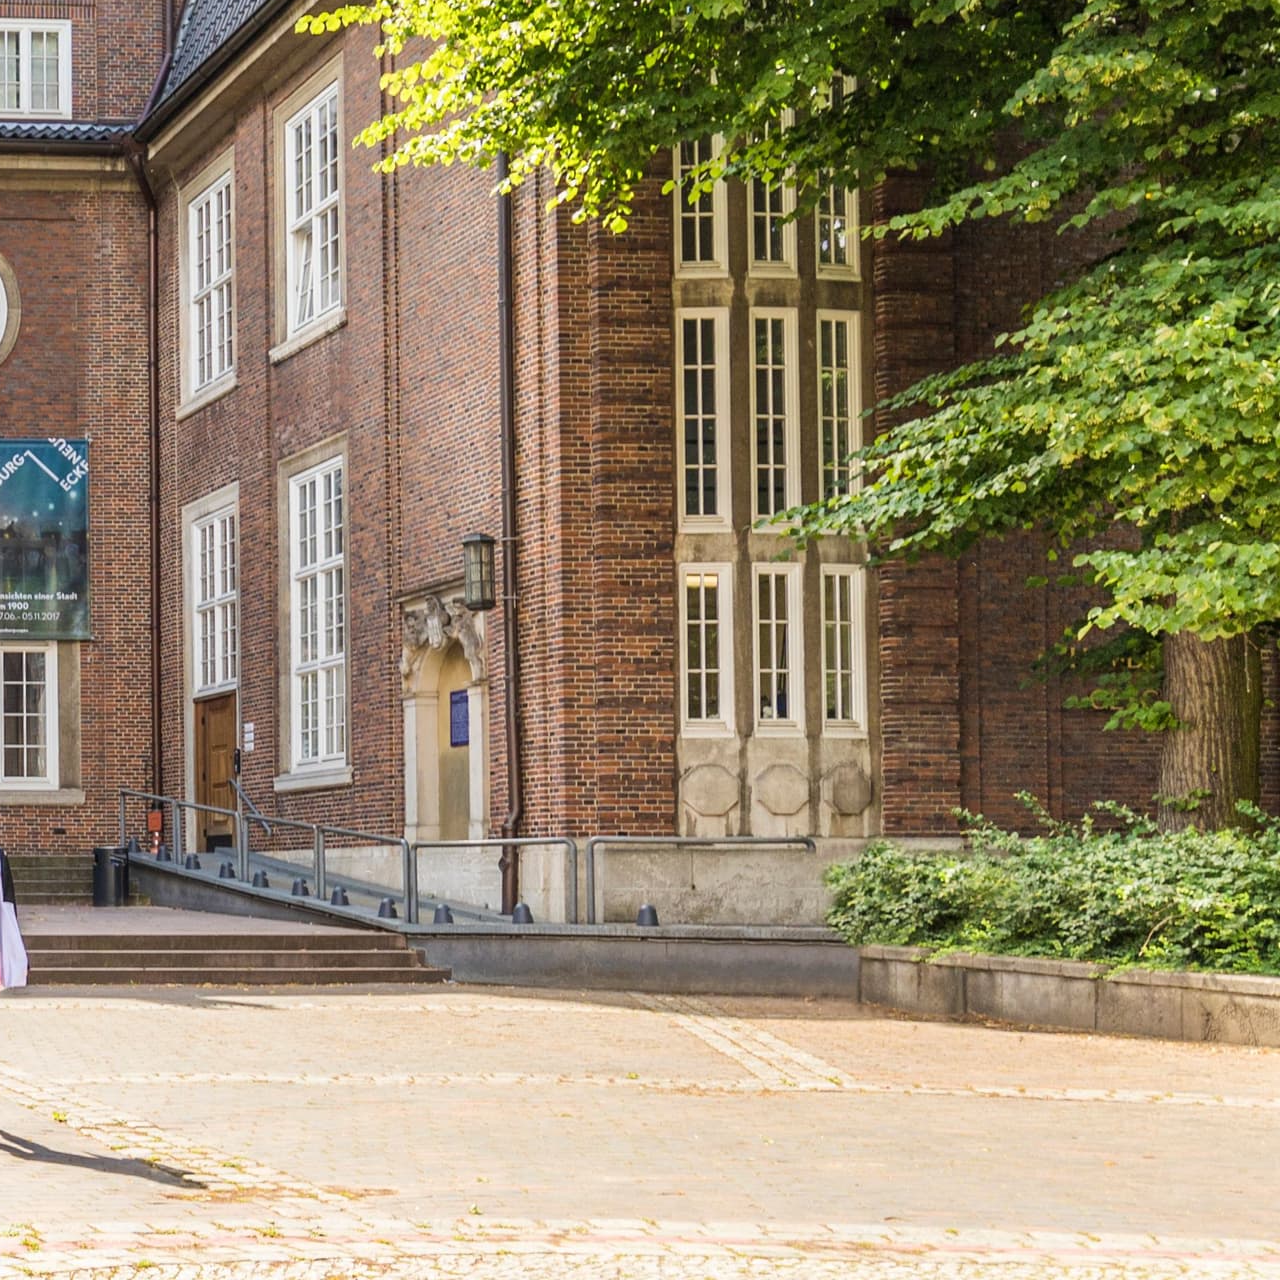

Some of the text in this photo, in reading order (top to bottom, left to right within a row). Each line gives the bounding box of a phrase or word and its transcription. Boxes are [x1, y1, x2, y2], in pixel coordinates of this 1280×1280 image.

[34, 592, 54, 600] einer
[56, 591, 78, 600] Stadt
[8, 602, 29, 610] 1900
